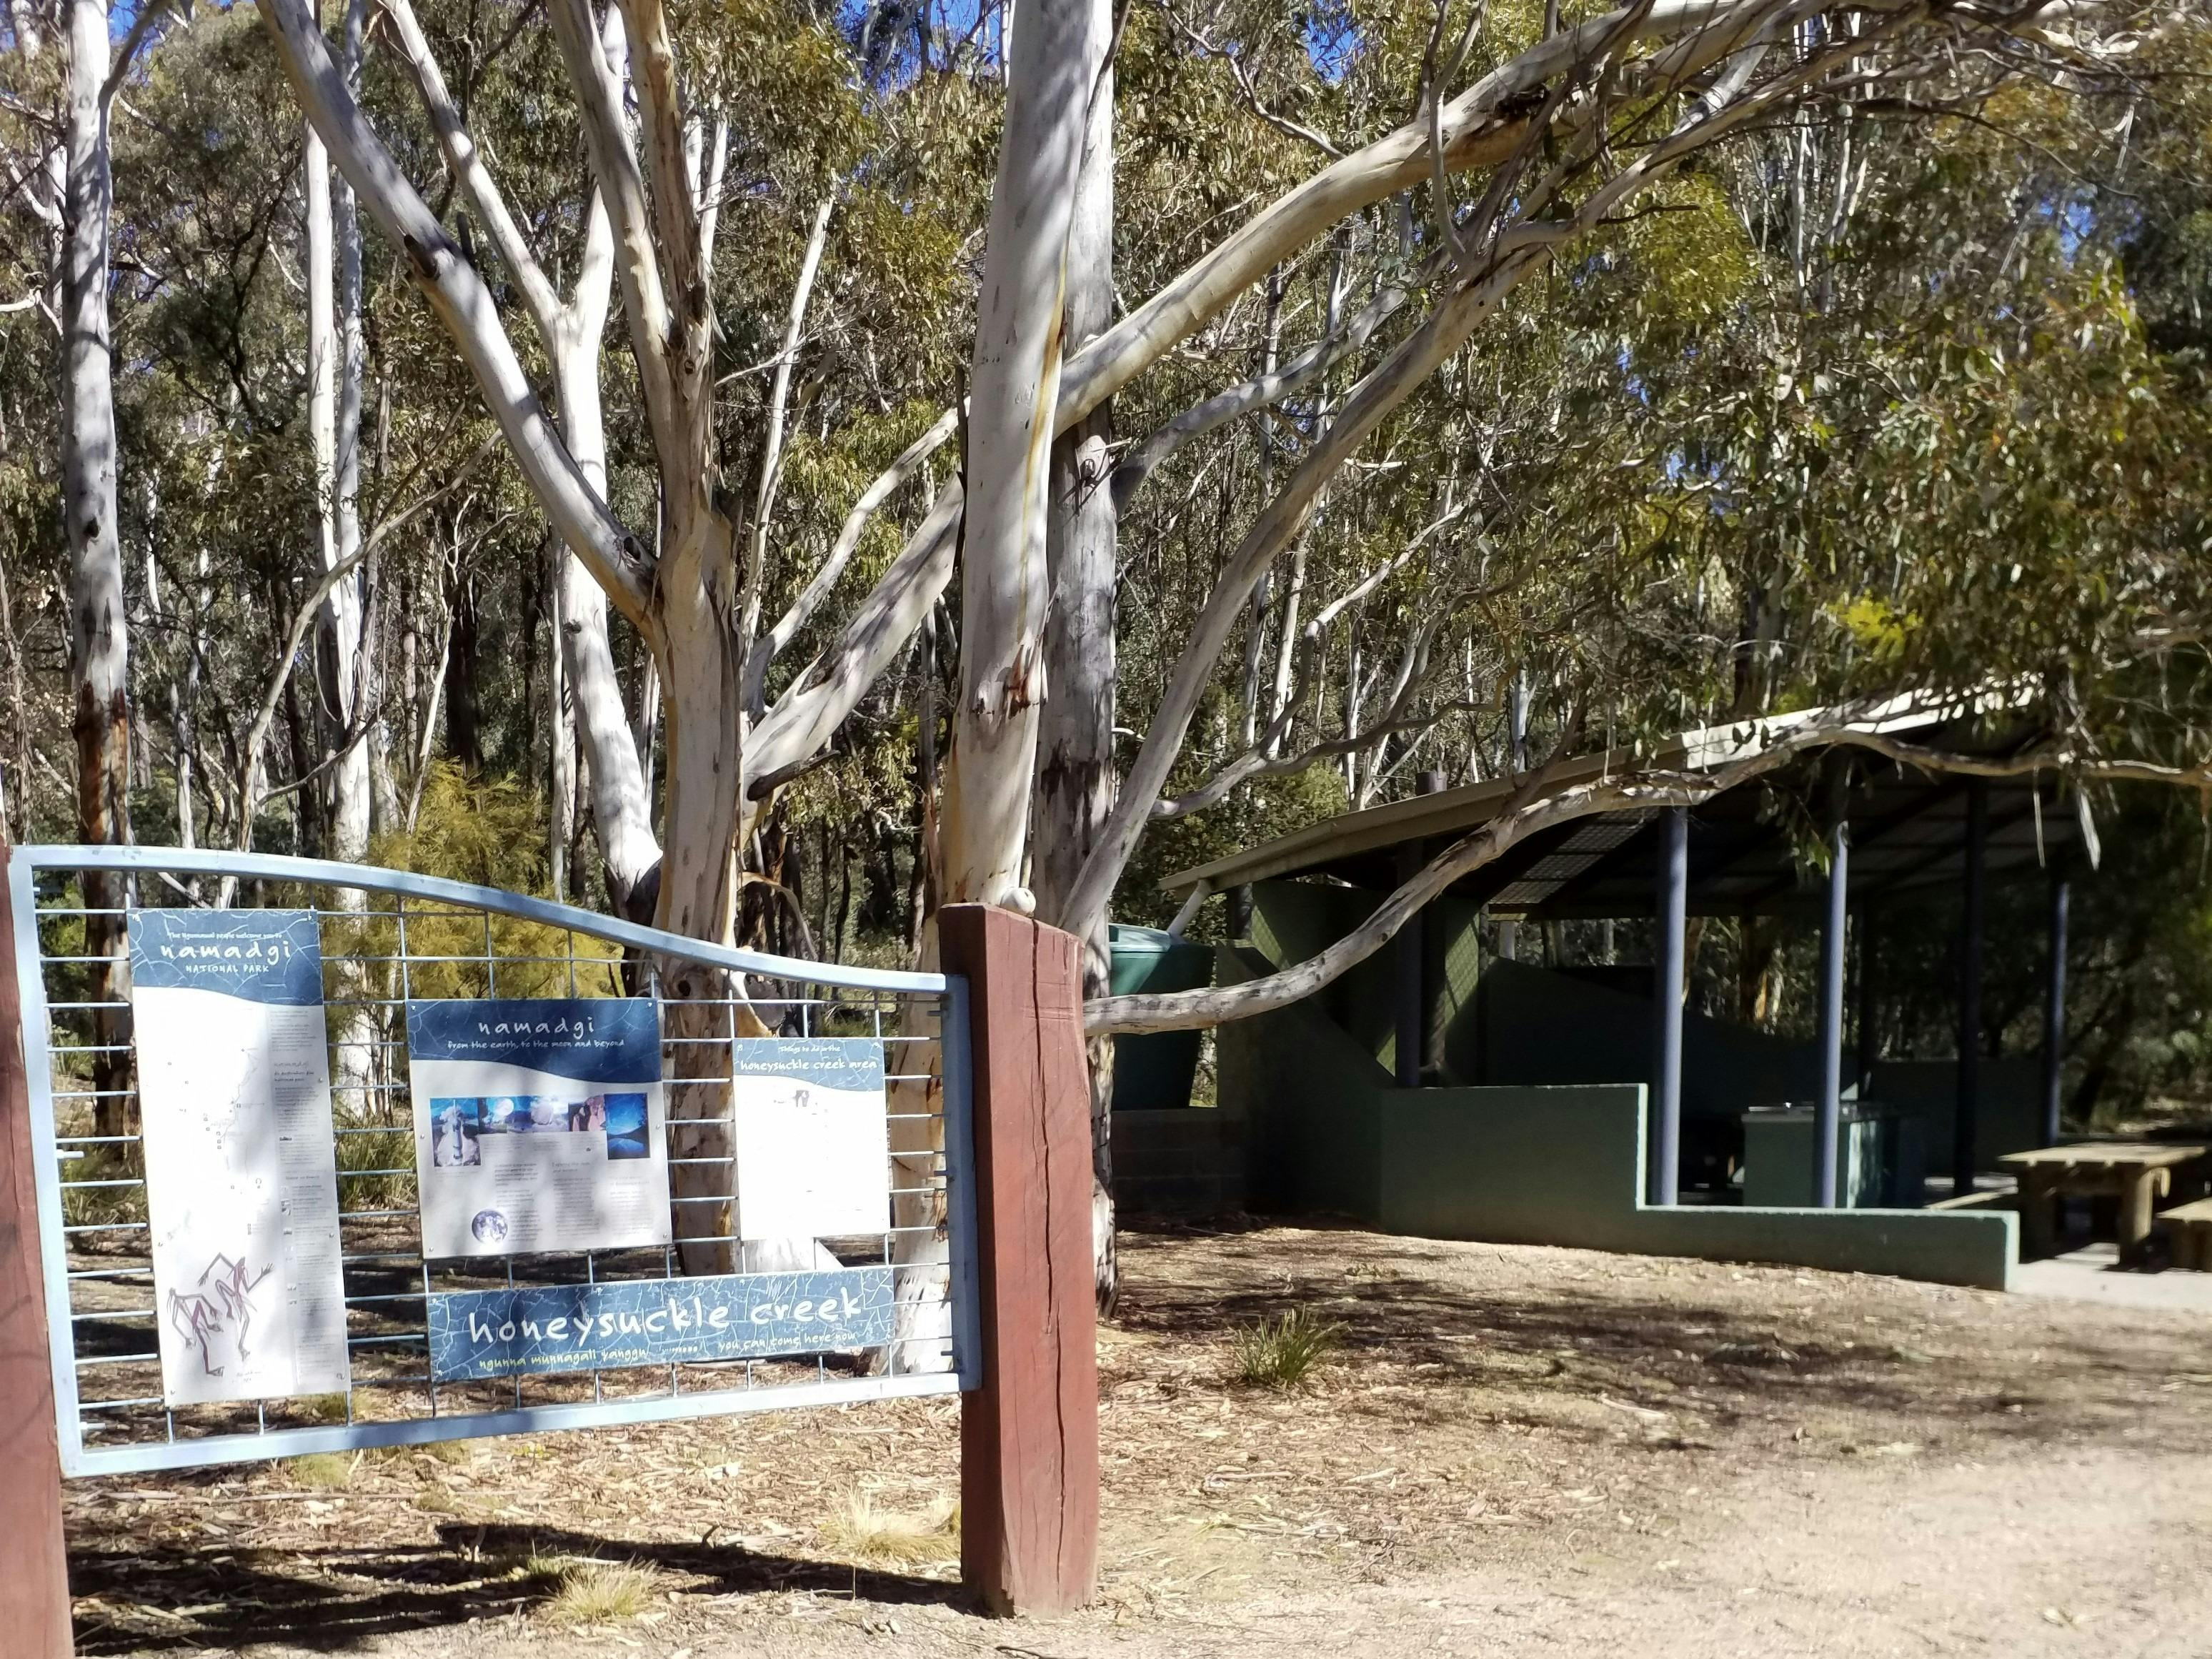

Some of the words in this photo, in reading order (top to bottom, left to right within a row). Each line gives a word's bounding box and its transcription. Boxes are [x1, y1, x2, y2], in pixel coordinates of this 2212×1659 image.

[160, 940, 291, 965] namadgi
[478, 1016, 594, 1039] namadgi
[447, 1040, 469, 1049] from
[471, 1039, 487, 1048] the
[490, 1040, 519, 1049] earth,
[533, 1039, 548, 1047] the
[740, 1060, 809, 1072] honeysuckle
[813, 1057, 846, 1070] creek
[469, 1296, 729, 1347] honeysuckle
[750, 1286, 862, 1325] creek
[479, 1357, 527, 1370] ngunna
[602, 1348, 647, 1362] yanggu
[717, 1341, 739, 1353] you
[743, 1338, 766, 1350] can
[770, 1335, 800, 1347] come
[804, 1331, 831, 1344] here
[835, 1332, 857, 1341] now
